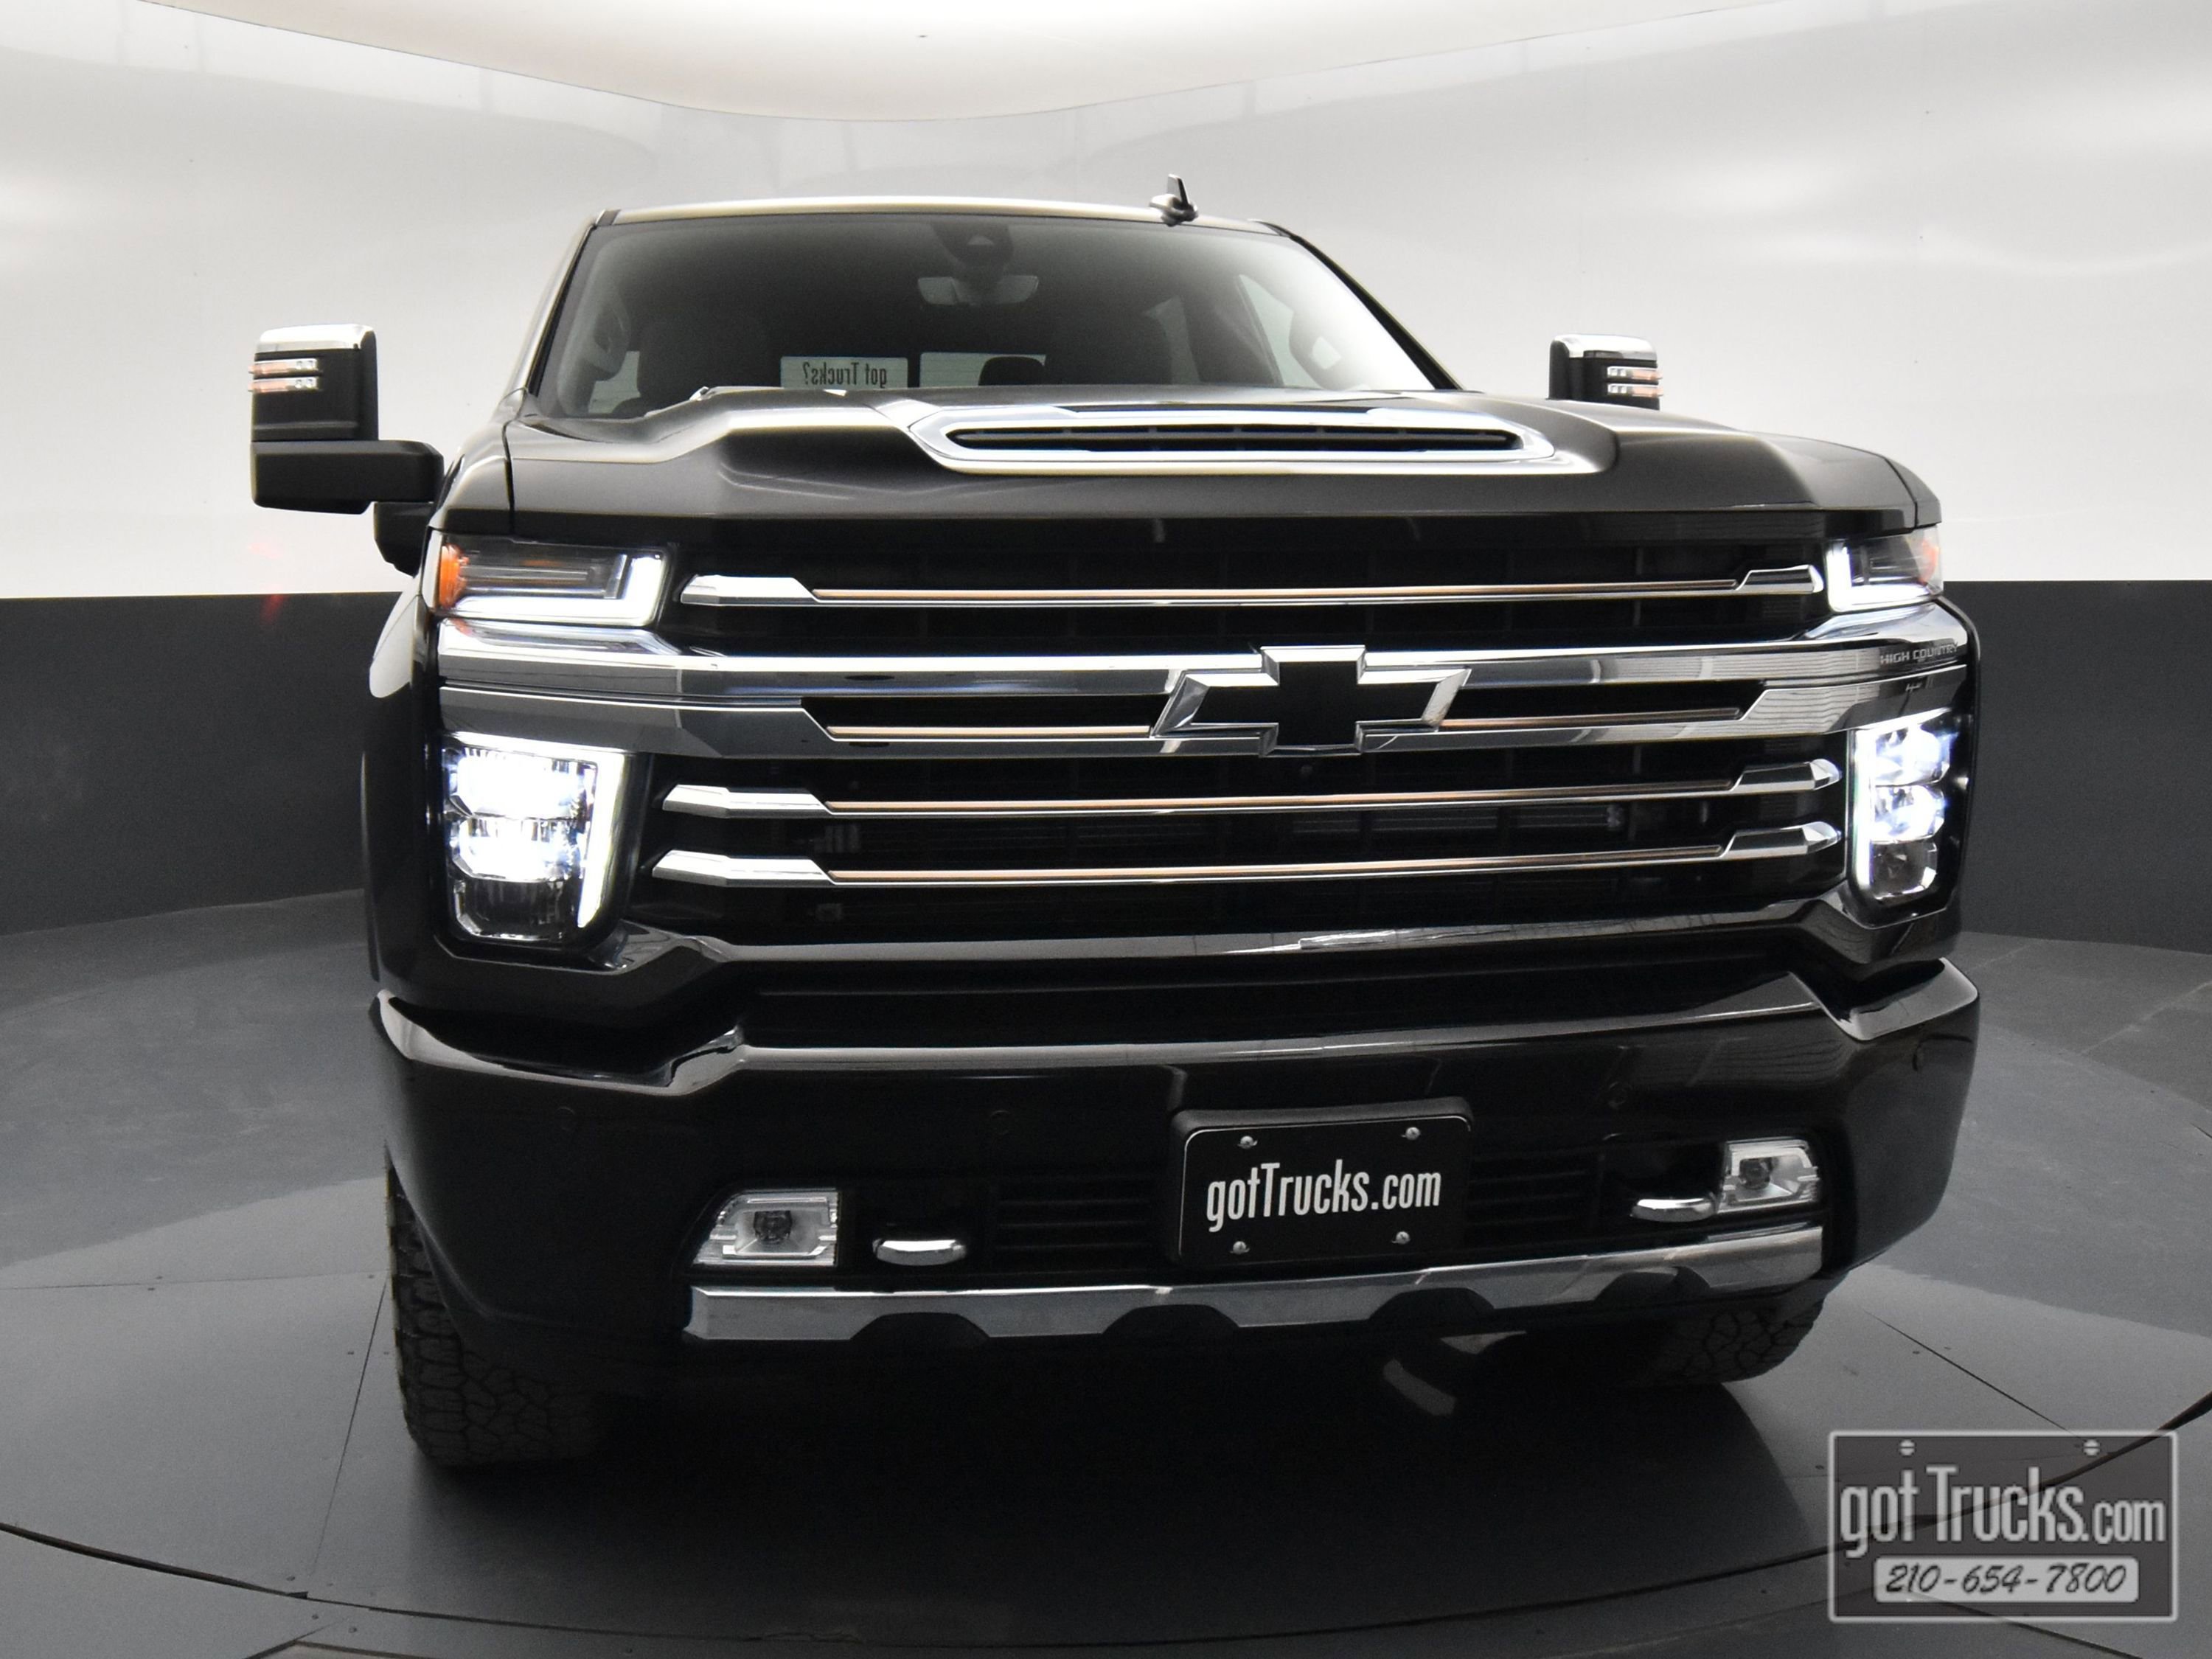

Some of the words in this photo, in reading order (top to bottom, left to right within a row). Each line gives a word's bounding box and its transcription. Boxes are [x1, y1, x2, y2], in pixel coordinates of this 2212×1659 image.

[1880, 653, 1910, 664] HIGH
[1913, 642, 1958, 659] COUNTRY
[1206, 1158, 1442, 1233] gotTrucks.com
